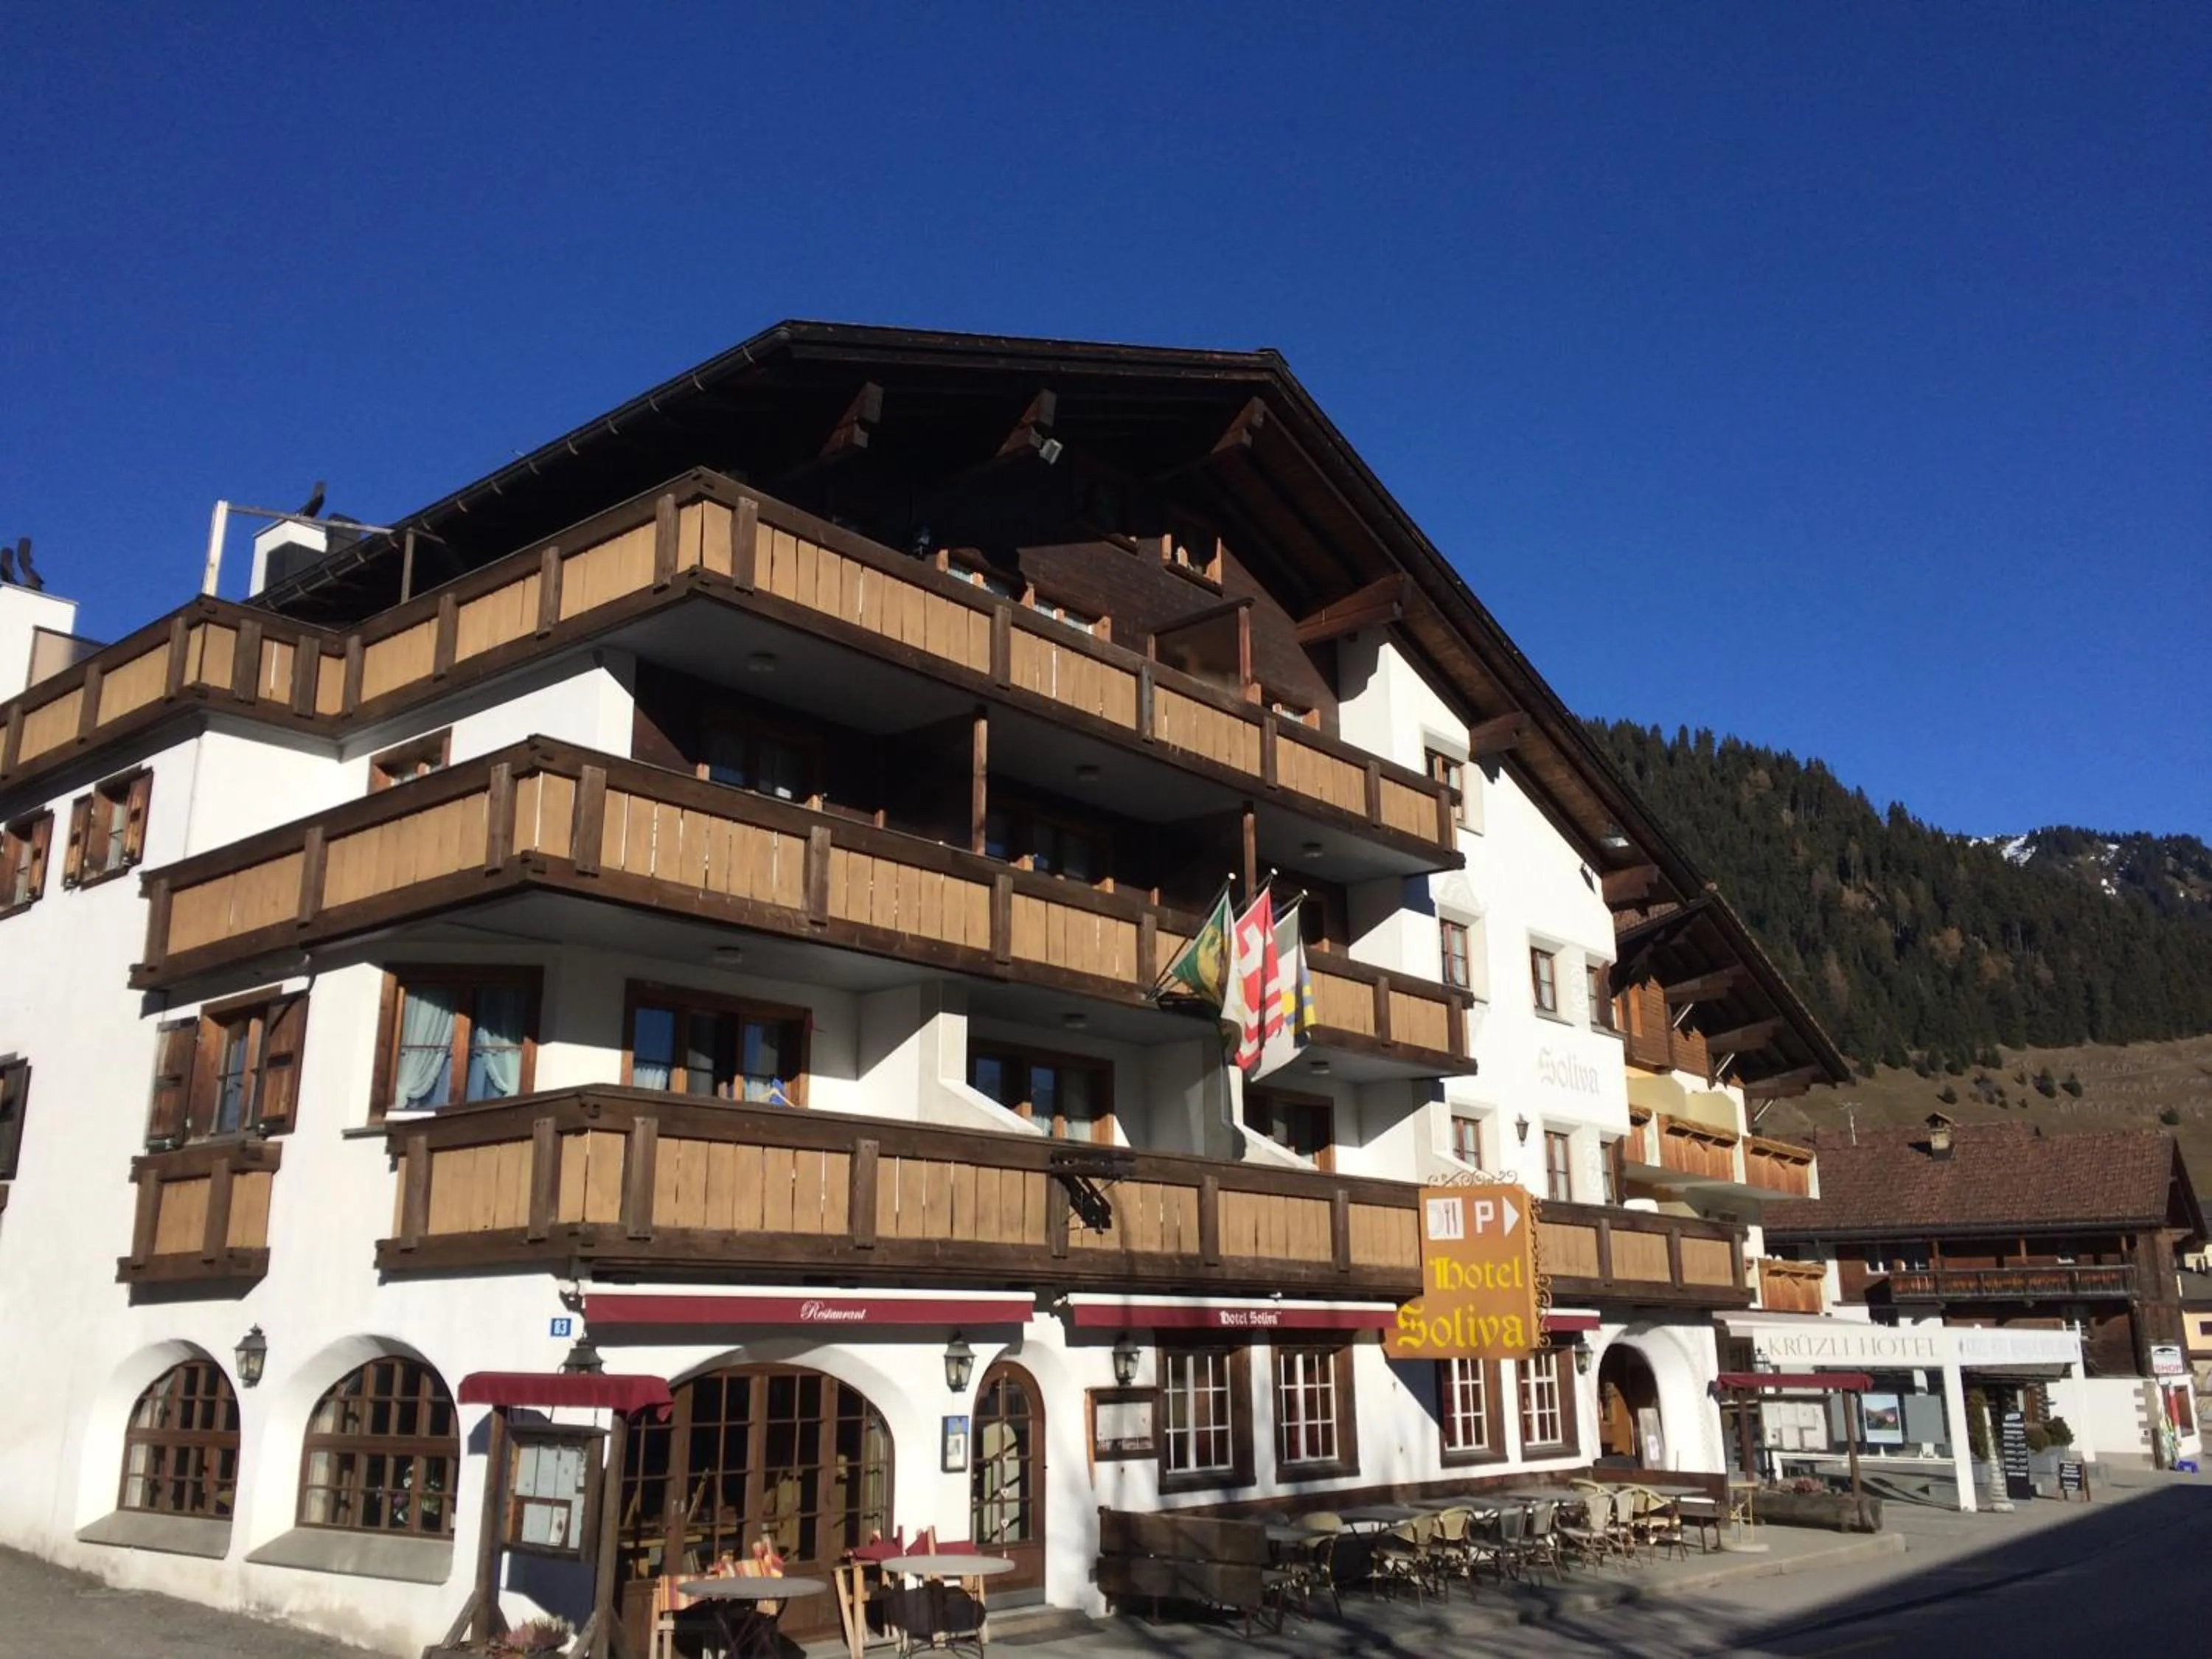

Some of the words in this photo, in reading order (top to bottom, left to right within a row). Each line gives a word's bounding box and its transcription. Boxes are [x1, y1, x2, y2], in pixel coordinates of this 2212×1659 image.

[1537, 1045, 1600, 1095] Soliva
[1475, 1200, 1495, 1234] P
[1429, 1256, 1523, 1290] Hotel
[554, 1320, 567, 1334] 83
[800, 1299, 866, 1321] Restaurant
[1396, 1304, 1526, 1348] Soliva
[1860, 1336, 1941, 1357] HOTEL
